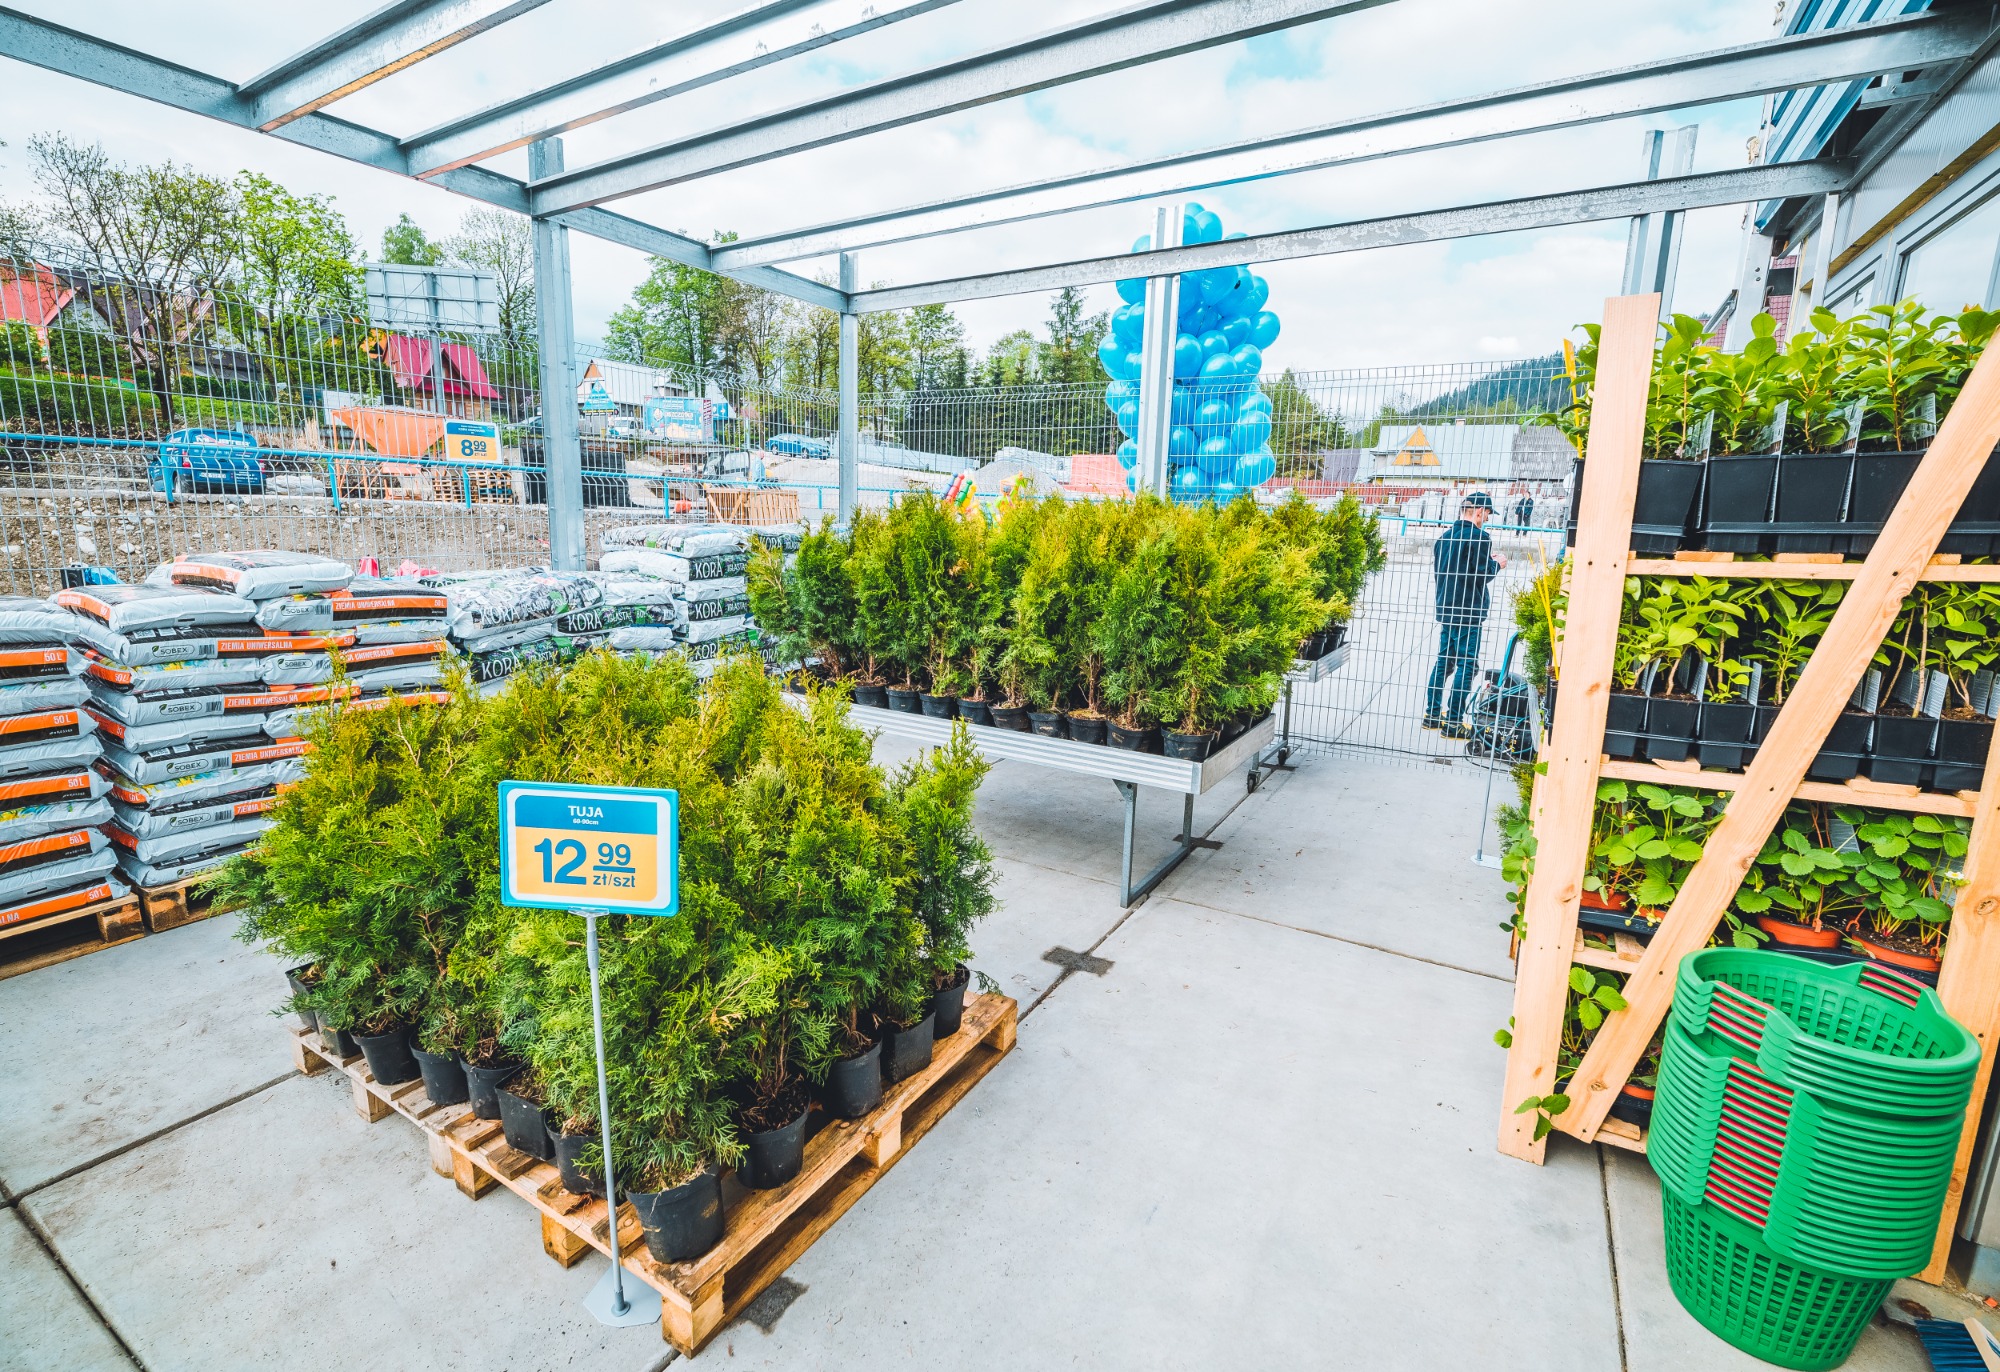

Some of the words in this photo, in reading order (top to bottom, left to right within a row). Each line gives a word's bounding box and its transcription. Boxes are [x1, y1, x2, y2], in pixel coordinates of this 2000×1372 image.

[461, 439, 474, 457] 8
[473, 440, 487, 450] 99
[695, 559, 723, 579] KORA
[335, 601, 356, 610] ZIEMIA
[695, 601, 723, 620] KORA
[479, 605, 521, 626] KORA
[568, 610, 602, 632] KORA
[159, 646, 188, 656] SOBEX
[221, 642, 245, 650] ZIEMIA
[246, 641, 293, 650] UNIWERSALNA
[227, 697, 252, 707] ZIEMIA
[253, 694, 298, 705] UNIWERSALNA
[167, 704, 195, 714] SOBEX
[235, 752, 258, 762] ZIEMIA
[259, 746, 304, 759] UNIWERSALNA
[175, 762, 202, 772] SOBEX
[237, 802, 258, 814] ZIEMIA
[567, 805, 604, 818] TUJA
[177, 816, 204, 825] SOBEX
[534, 837, 587, 885] 12
[597, 842, 631, 866] 99
[592, 873, 636, 888] zł/szt
